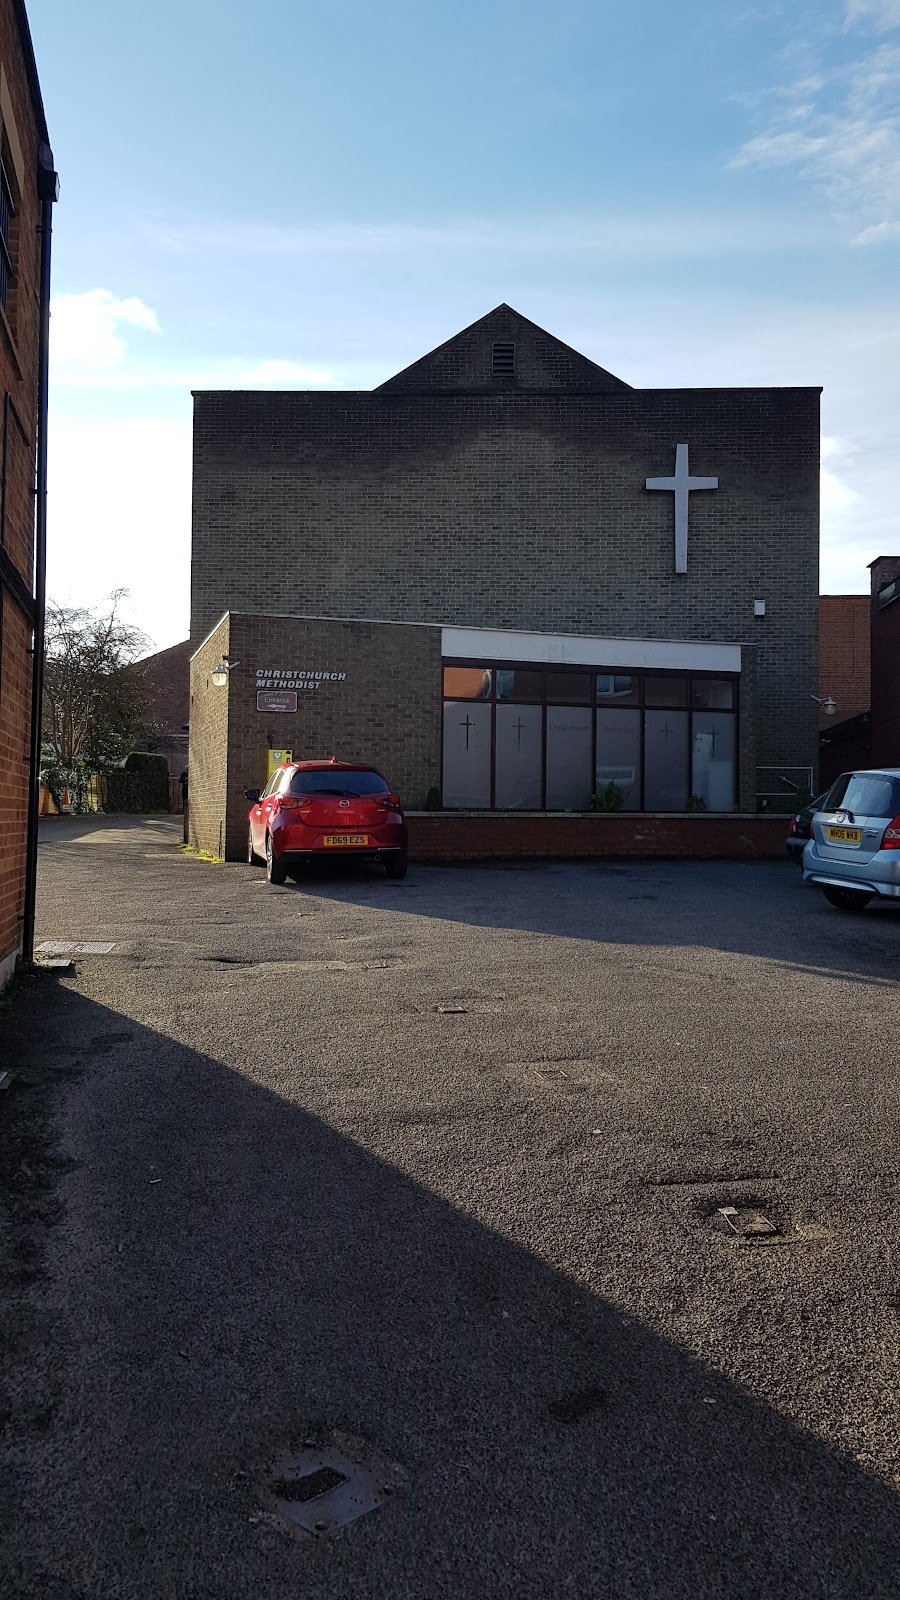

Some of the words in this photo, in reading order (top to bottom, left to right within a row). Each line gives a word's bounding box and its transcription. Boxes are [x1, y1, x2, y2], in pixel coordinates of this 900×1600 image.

[255, 669, 347, 681] CHRISTCHURCH
[255, 679, 321, 690] METHODIST
[264, 696, 291, 704] Entrance
[326, 836, 348, 845] FD69
[349, 836, 365, 844] EZS
